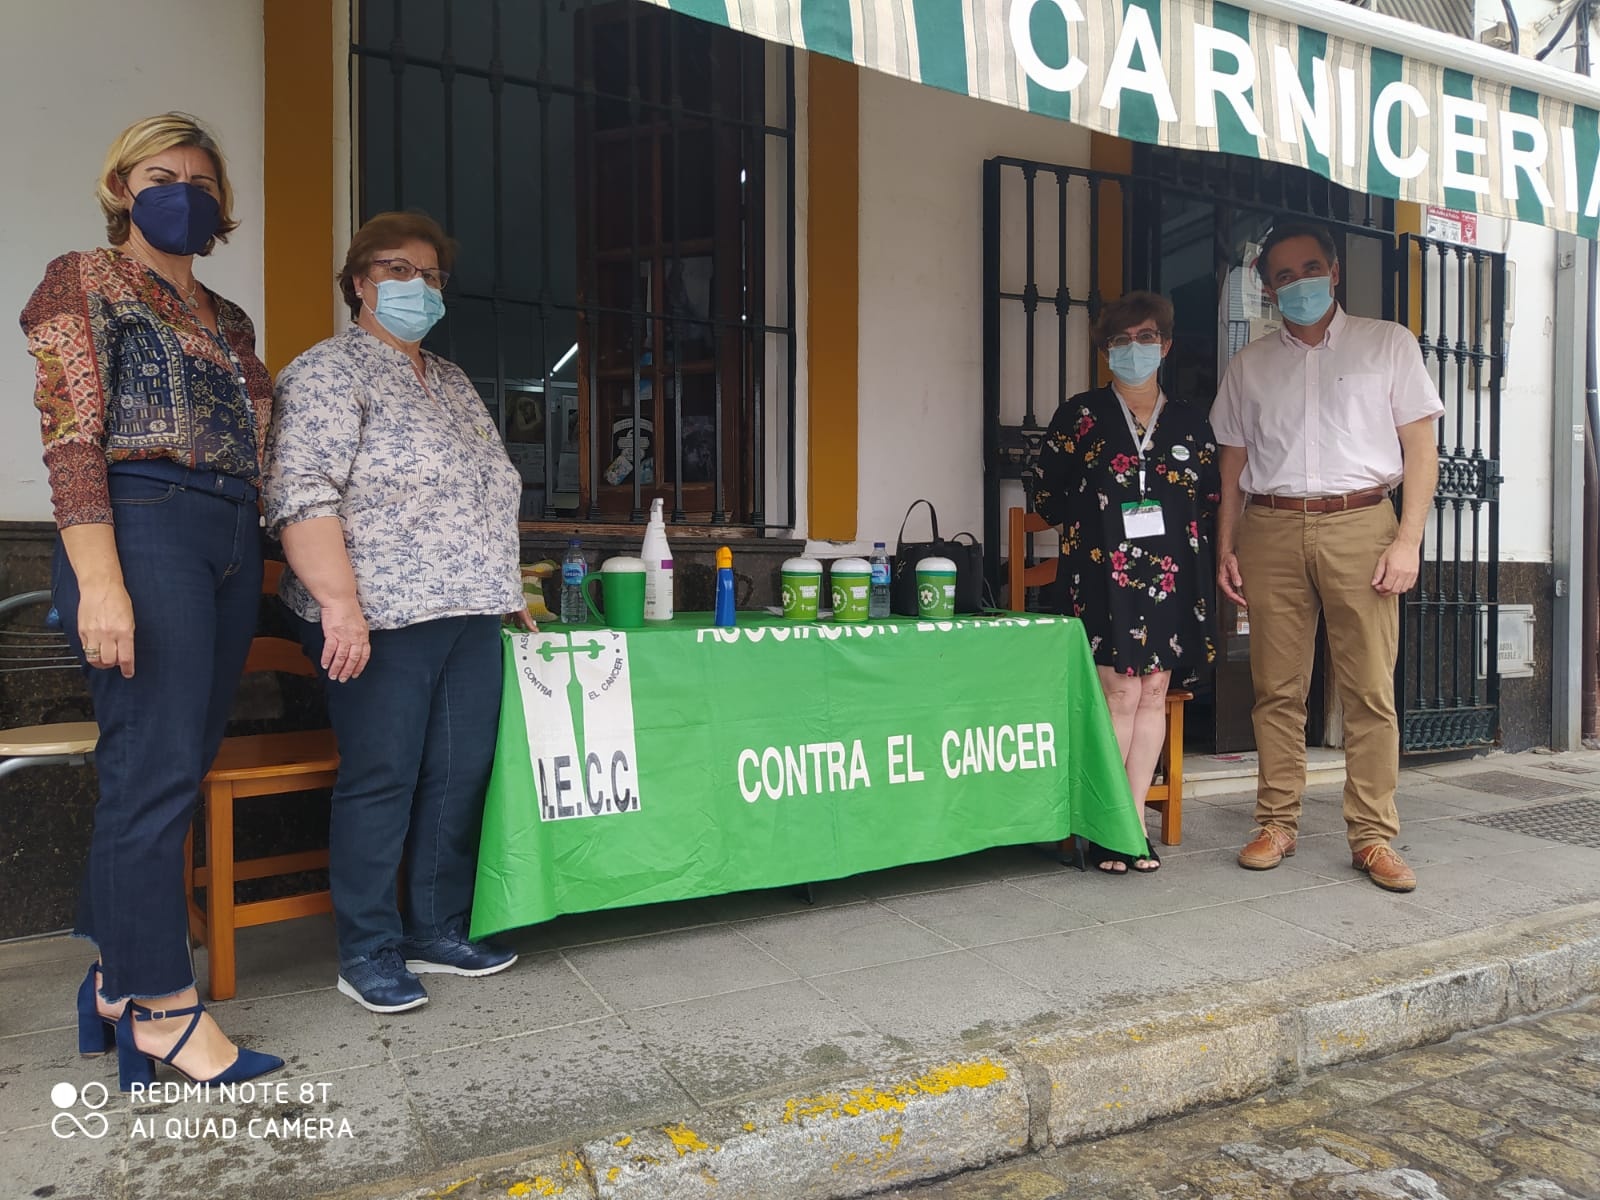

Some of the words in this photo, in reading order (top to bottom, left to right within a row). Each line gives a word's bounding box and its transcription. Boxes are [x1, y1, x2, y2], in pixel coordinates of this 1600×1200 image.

[1008, 0, 1600, 217] CARNICERI
[523, 666, 552, 698] CONTRA
[588, 690, 600, 700] EL
[601, 657, 623, 691] CANCER
[737, 739, 871, 803] CONTRA
[887, 734, 925, 784] EL
[941, 722, 1057, 779] CANCER
